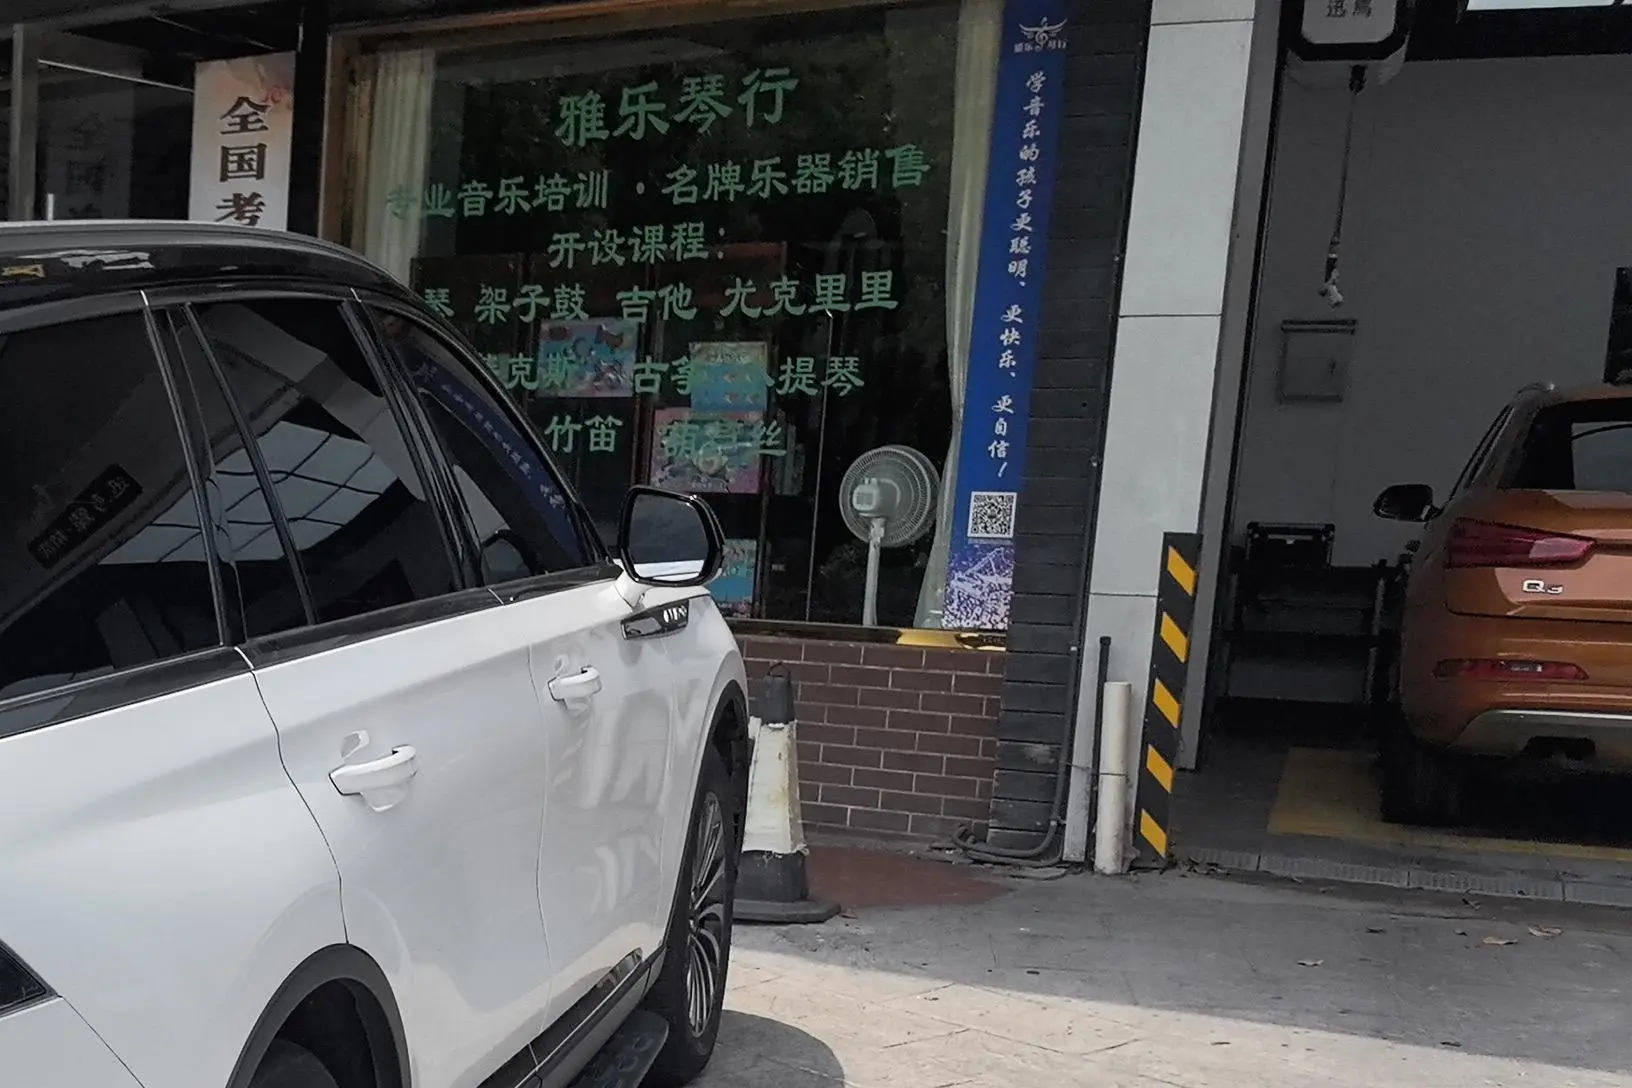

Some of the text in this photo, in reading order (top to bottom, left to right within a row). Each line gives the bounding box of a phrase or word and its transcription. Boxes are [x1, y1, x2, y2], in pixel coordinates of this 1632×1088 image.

[555, 66, 799, 148] 雅乐琴行
[548, 221, 726, 269] 开设课程：
[473, 283, 590, 325] 架子鼓
[616, 282, 698, 323] 吉他
[719, 270, 899, 318] 尤克里里
[764, 356, 865, 397] 提琴
[544, 415, 623, 453] 竹笛
